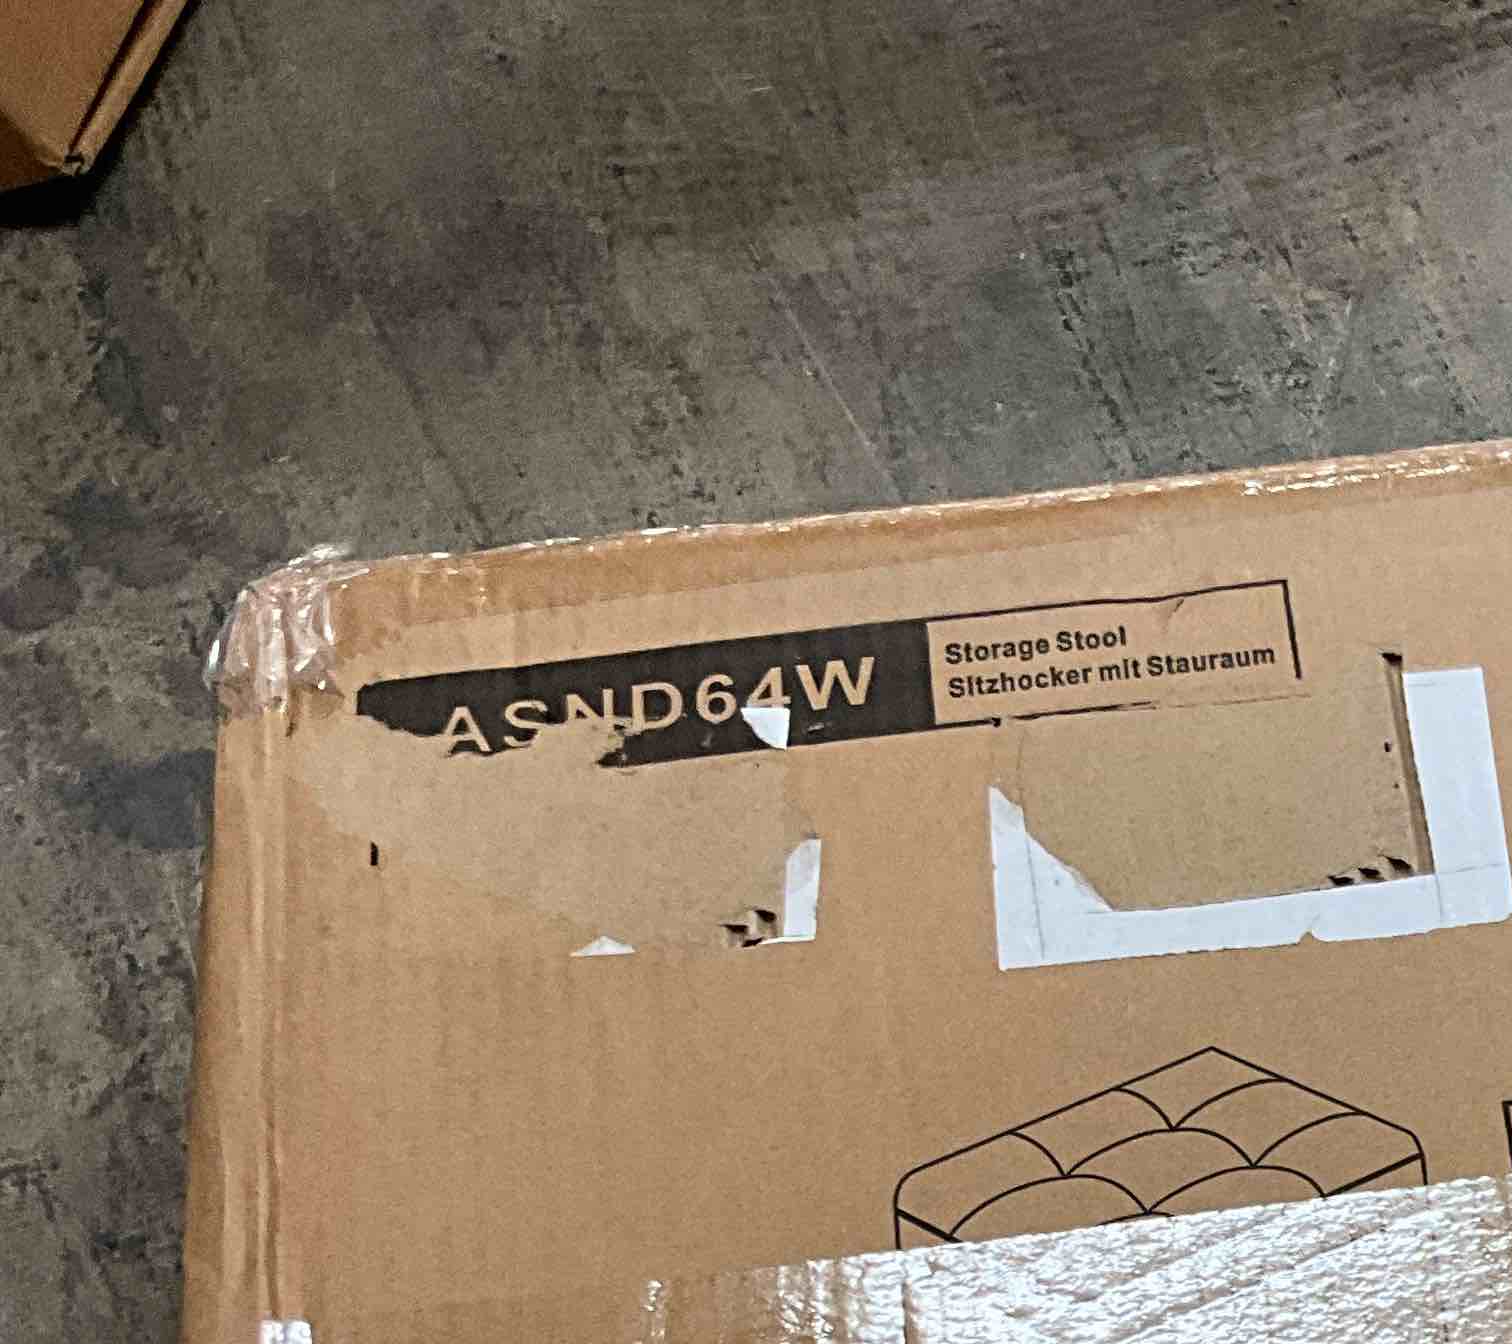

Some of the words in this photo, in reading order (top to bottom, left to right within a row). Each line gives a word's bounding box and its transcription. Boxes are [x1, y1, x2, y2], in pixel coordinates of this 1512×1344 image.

[944, 637, 1050, 667] Storage
[1056, 626, 1127, 653] Stool
[948, 662, 1096, 698] Sitzhocker
[1098, 658, 1142, 682] mit
[1147, 644, 1276, 678] Stauraum
[441, 656, 876, 755] ASND64W
